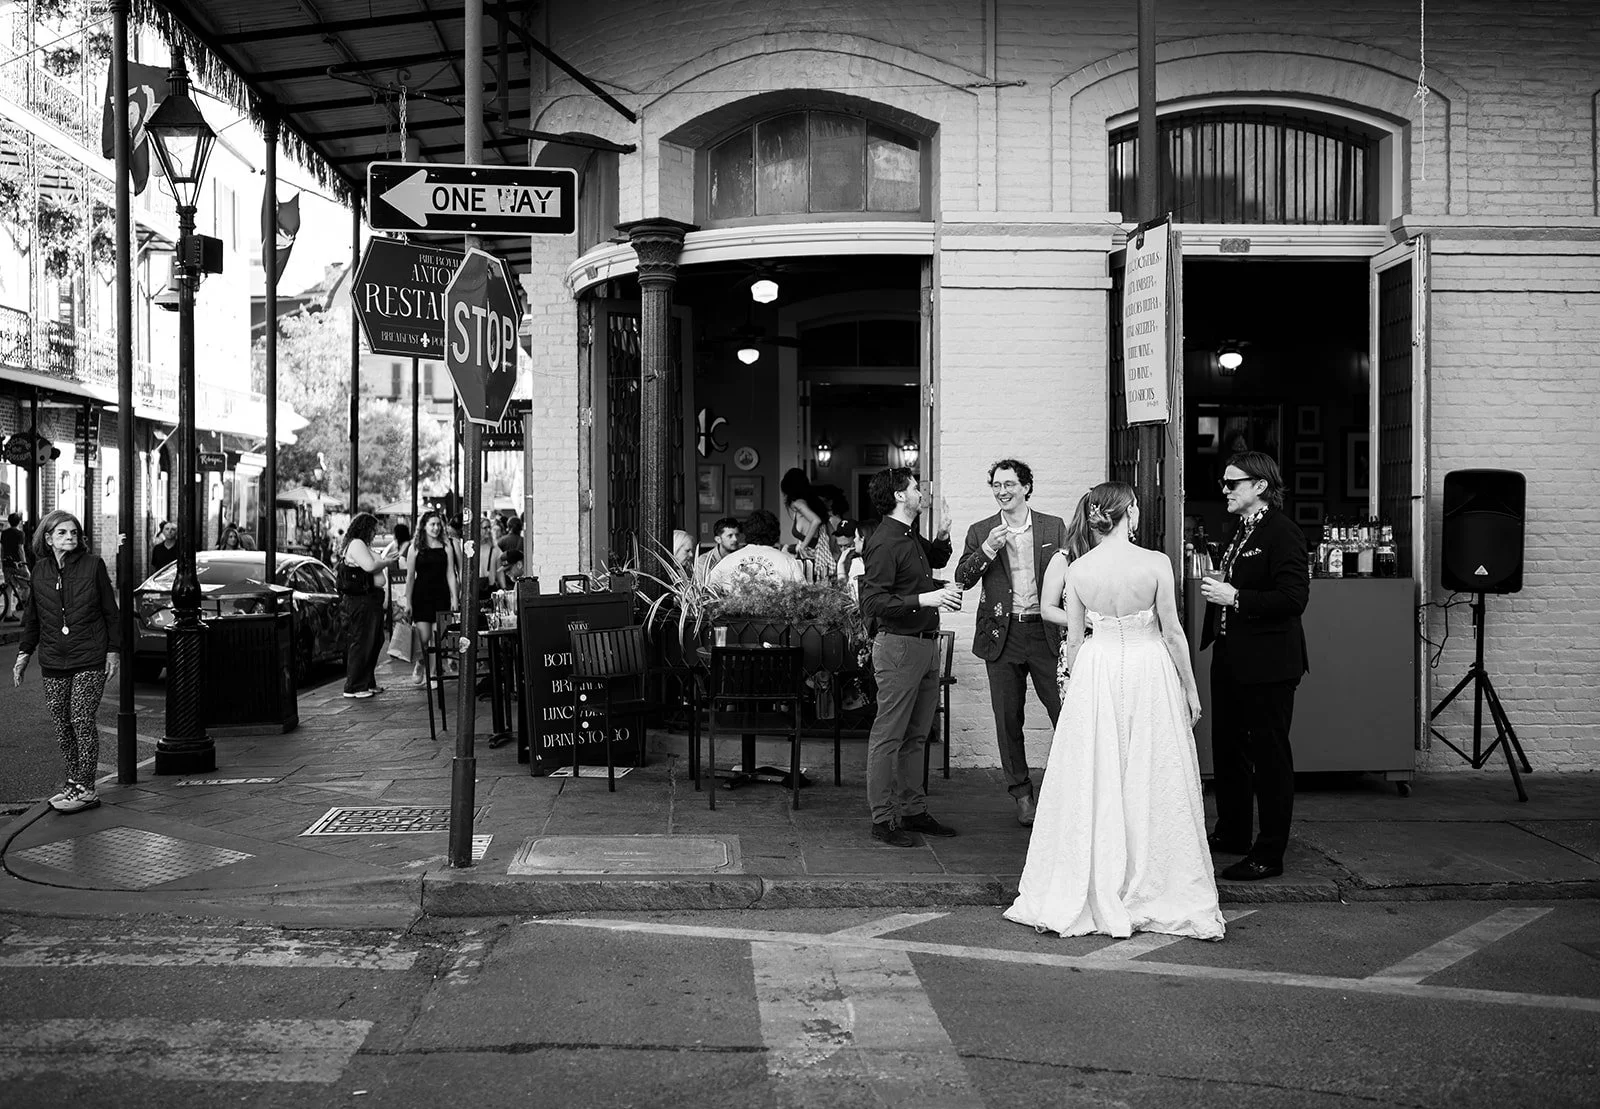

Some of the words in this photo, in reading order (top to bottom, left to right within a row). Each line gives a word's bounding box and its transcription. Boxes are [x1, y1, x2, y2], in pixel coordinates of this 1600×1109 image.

[432, 186, 487, 212] ONE
[498, 188, 554, 214] WAY
[435, 256, 463, 268] ROYAL
[411, 263, 455, 286] ANTOI
[452, 301, 515, 373] STOP
[543, 705, 575, 721] LUNC
[543, 731, 585, 748] DRINS
